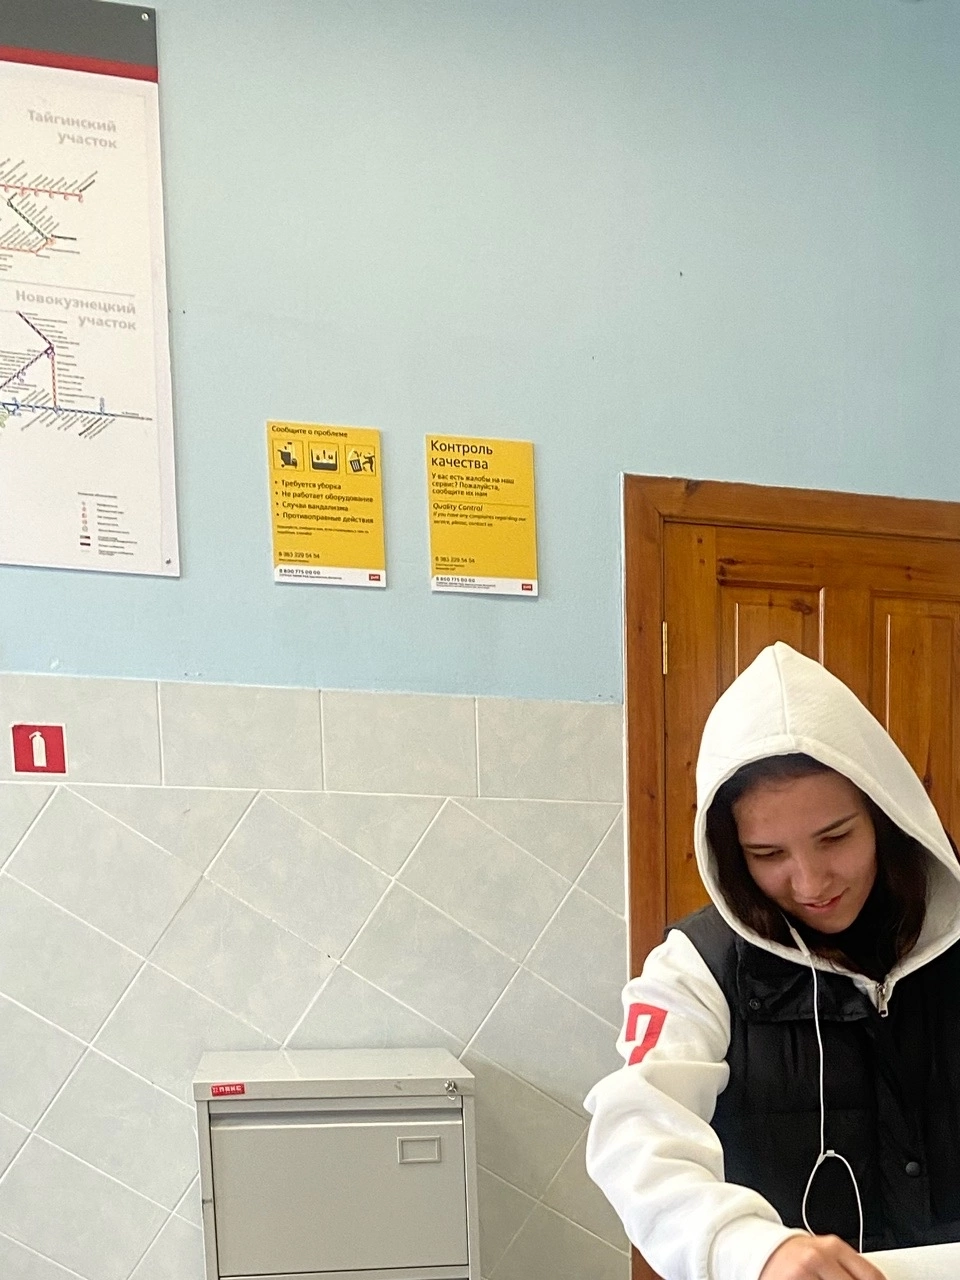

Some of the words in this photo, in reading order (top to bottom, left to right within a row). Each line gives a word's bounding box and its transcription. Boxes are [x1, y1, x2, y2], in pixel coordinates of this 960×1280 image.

[28, 109, 117, 133] Тайгинский
[57, 132, 118, 149] участок
[15, 290, 136, 315] Новокузнецкий
[78, 315, 137, 331] участок
[271, 425, 307, 434] Сообщите
[313, 429, 348, 438] проблеме
[430, 439, 494, 456] Контроль
[431, 457, 489, 470] качества
[317, 482, 342, 490] уборка
[433, 502, 457, 511] Quality
[458, 503, 483, 512] Control
